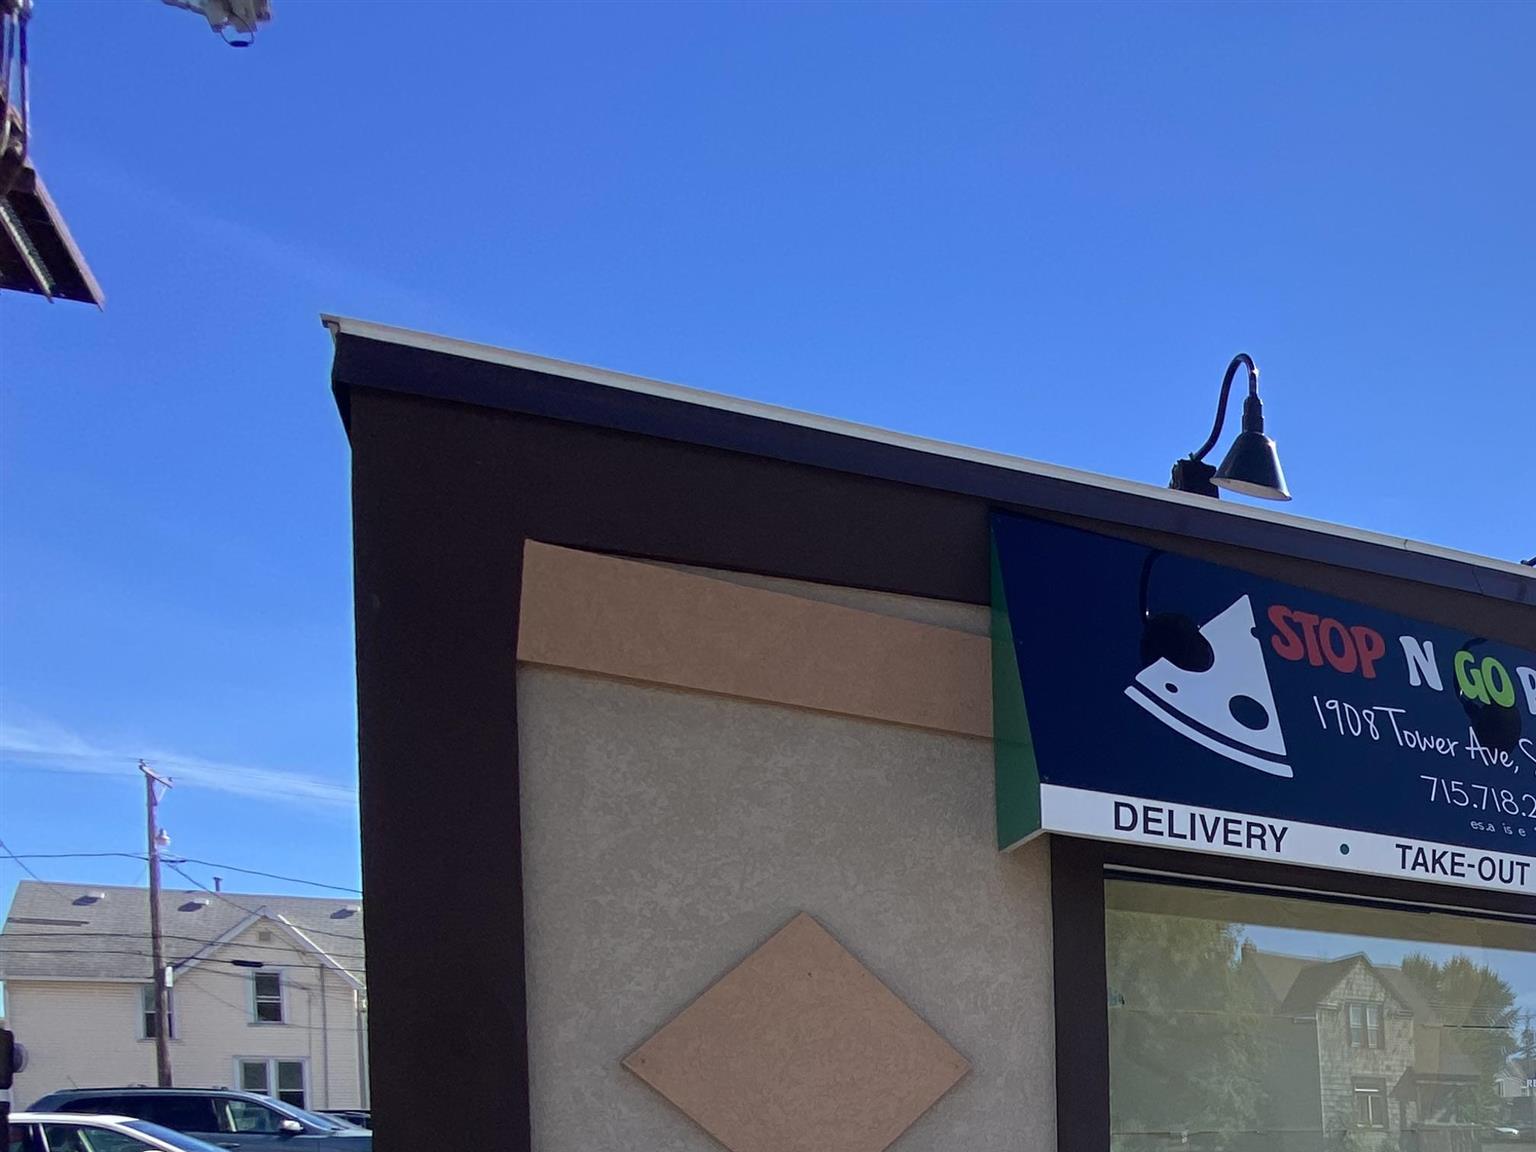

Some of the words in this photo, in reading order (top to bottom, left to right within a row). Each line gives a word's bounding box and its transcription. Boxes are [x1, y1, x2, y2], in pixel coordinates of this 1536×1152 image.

[1267, 604, 1386, 679] STOP
[1399, 635, 1444, 692] N
[1454, 650, 1516, 708] GO
[1312, 695, 1380, 741] 1908
[1372, 705, 1459, 758] Tower
[1465, 725, 1519, 774] Ave,
[1113, 800, 1289, 853] DELIVERY
[1395, 843, 1531, 886] TAKE-OUT
